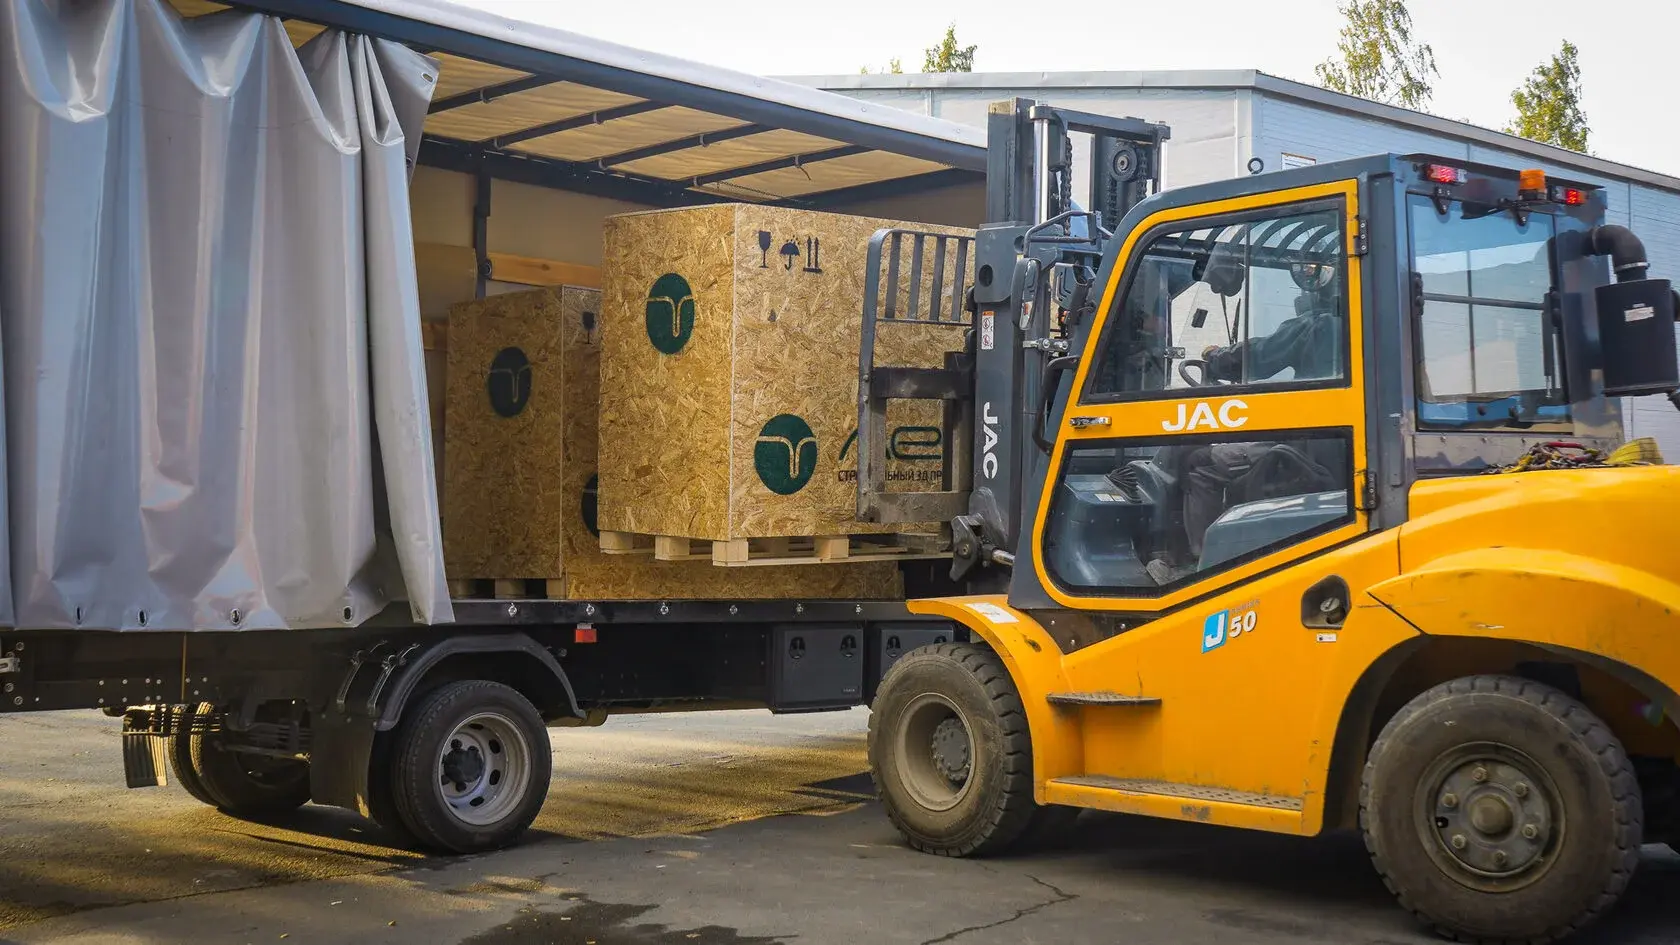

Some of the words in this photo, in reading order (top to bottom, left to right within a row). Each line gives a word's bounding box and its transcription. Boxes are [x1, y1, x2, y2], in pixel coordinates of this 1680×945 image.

[1162, 399, 1249, 431] JAC
[983, 401, 998, 479] JAC
[1205, 613, 1226, 648] J
[1229, 610, 1257, 638] 50
